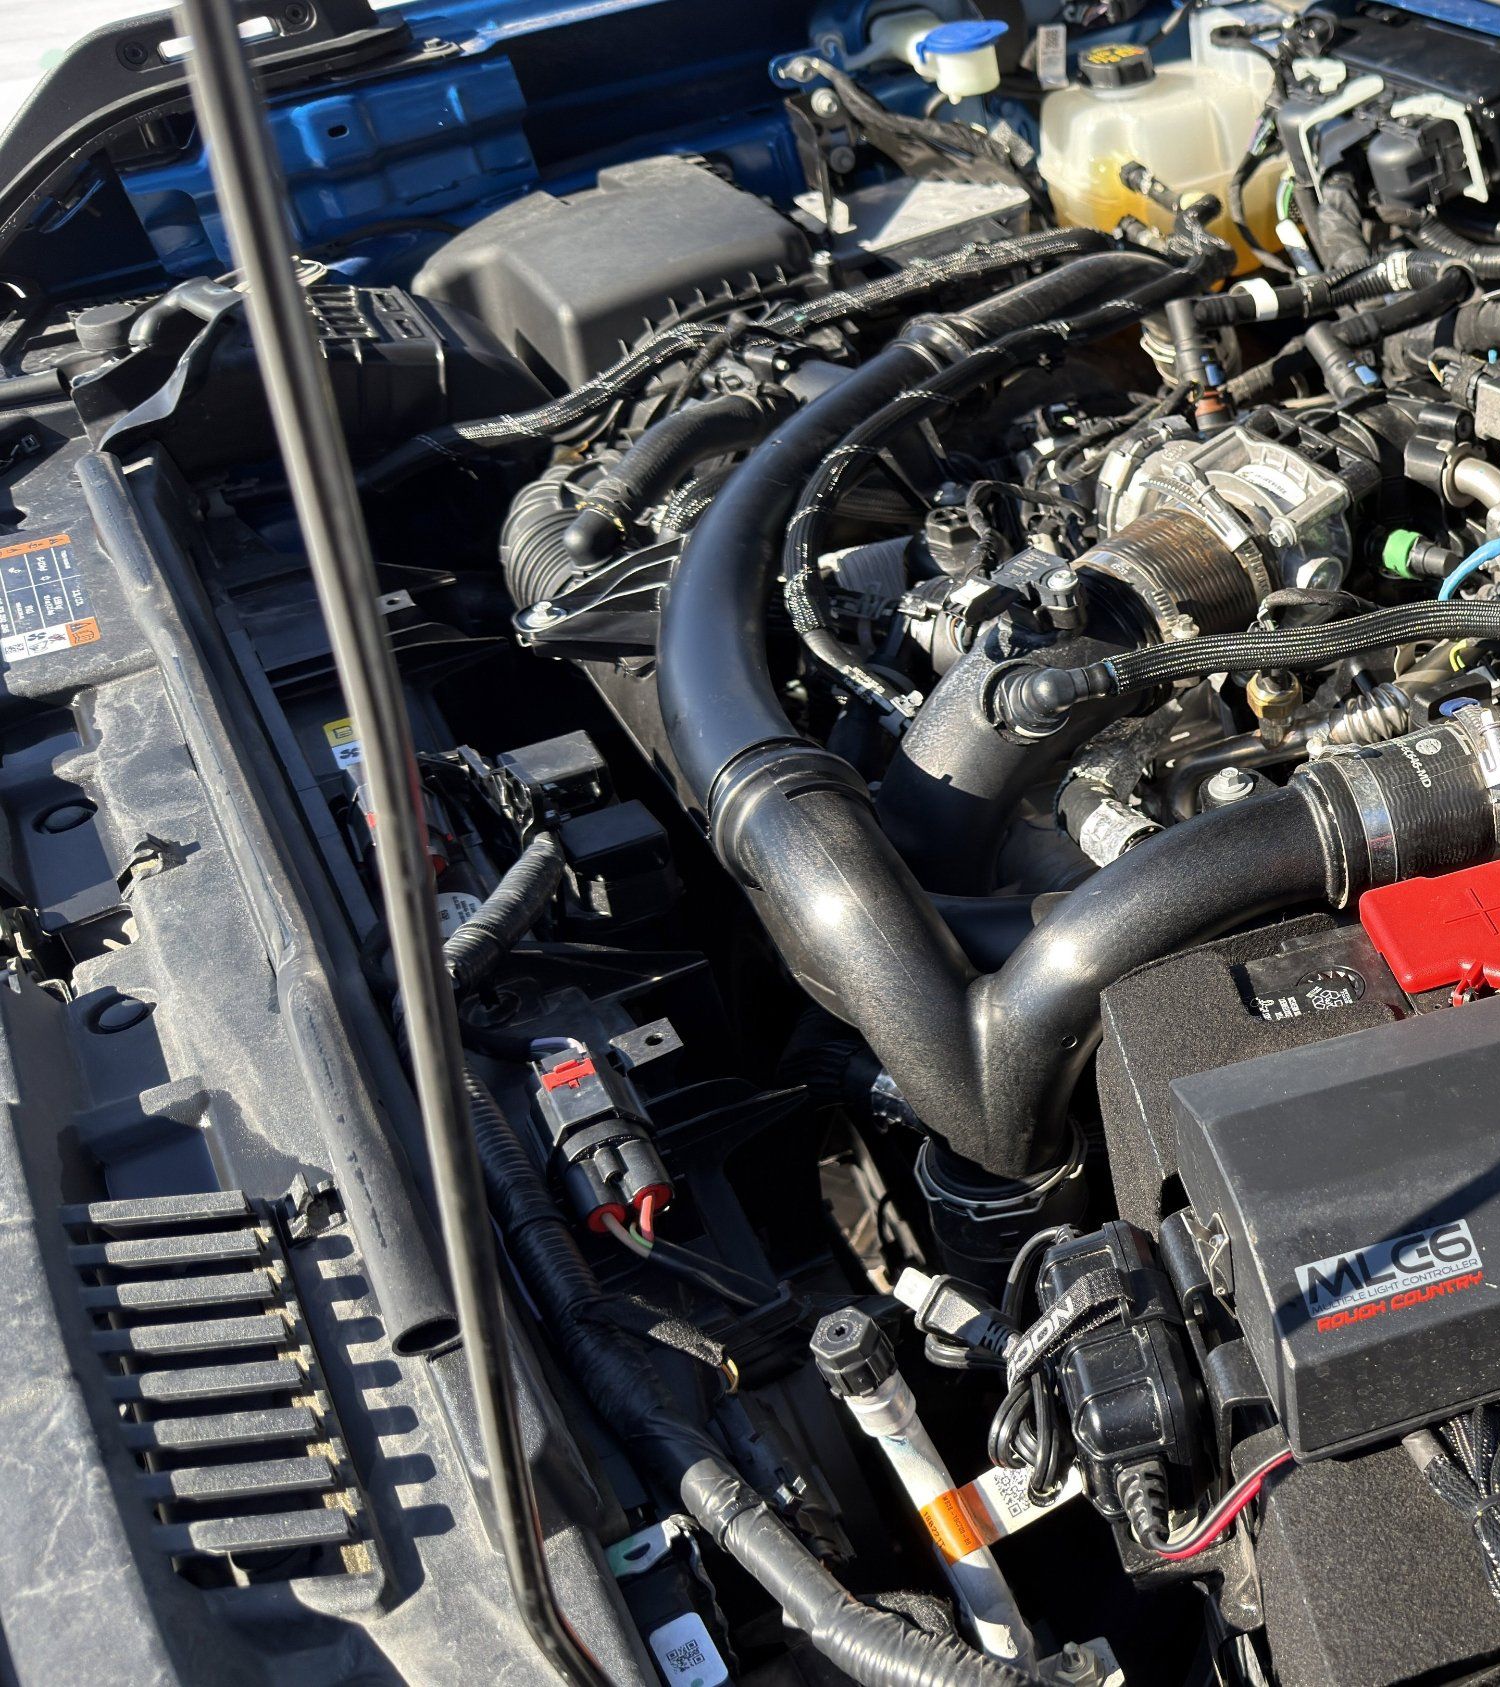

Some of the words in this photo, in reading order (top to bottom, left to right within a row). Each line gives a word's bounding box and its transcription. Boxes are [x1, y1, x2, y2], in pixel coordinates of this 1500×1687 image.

[1311, 1290, 1366, 1314] MULTIPLE
[1367, 1281, 1399, 1297] LIGHT
[1401, 1257, 1478, 1286] CONTROLLER
[1315, 1300, 1388, 1332] ROUGH
[1389, 1270, 1485, 1310] COUNTRY
